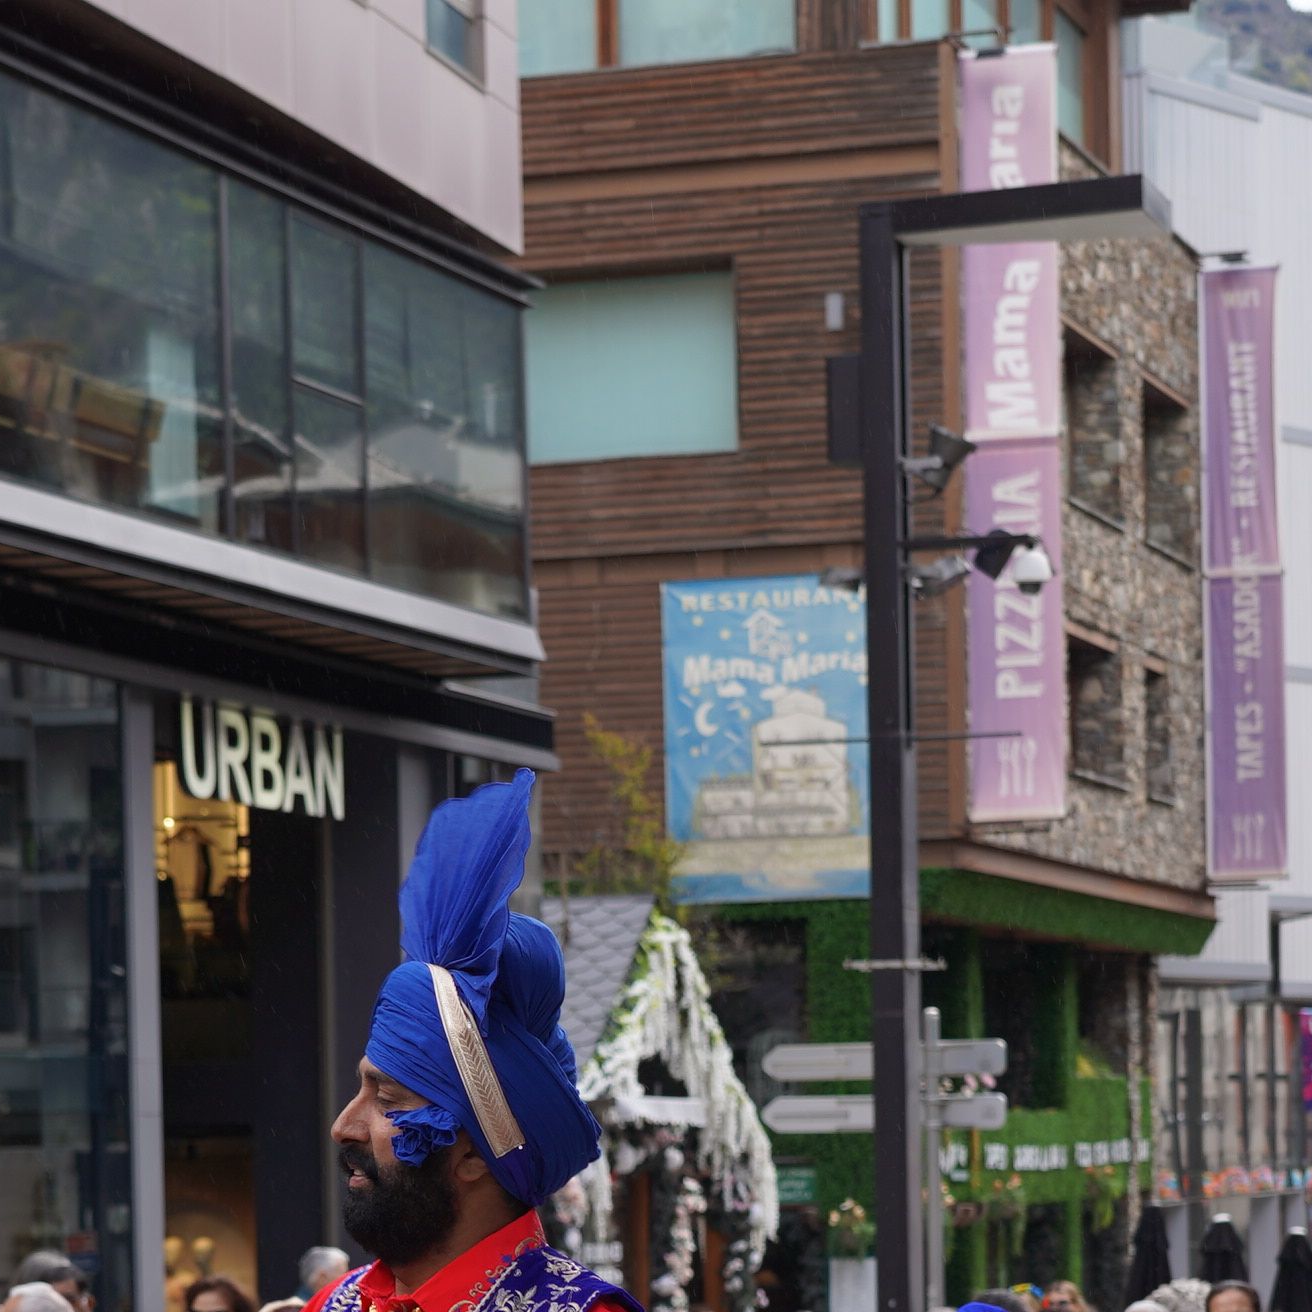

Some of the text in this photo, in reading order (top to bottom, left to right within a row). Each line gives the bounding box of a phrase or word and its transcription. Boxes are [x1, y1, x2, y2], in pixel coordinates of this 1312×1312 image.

[986, 83, 1041, 433] Mama aria
[1227, 341, 1259, 508] RESTAURANT
[991, 470, 1045, 699] PIZZIA
[683, 651, 867, 688] Mama Maria
[1235, 703, 1265, 783] TAPES
[181, 692, 346, 821] URBAN
